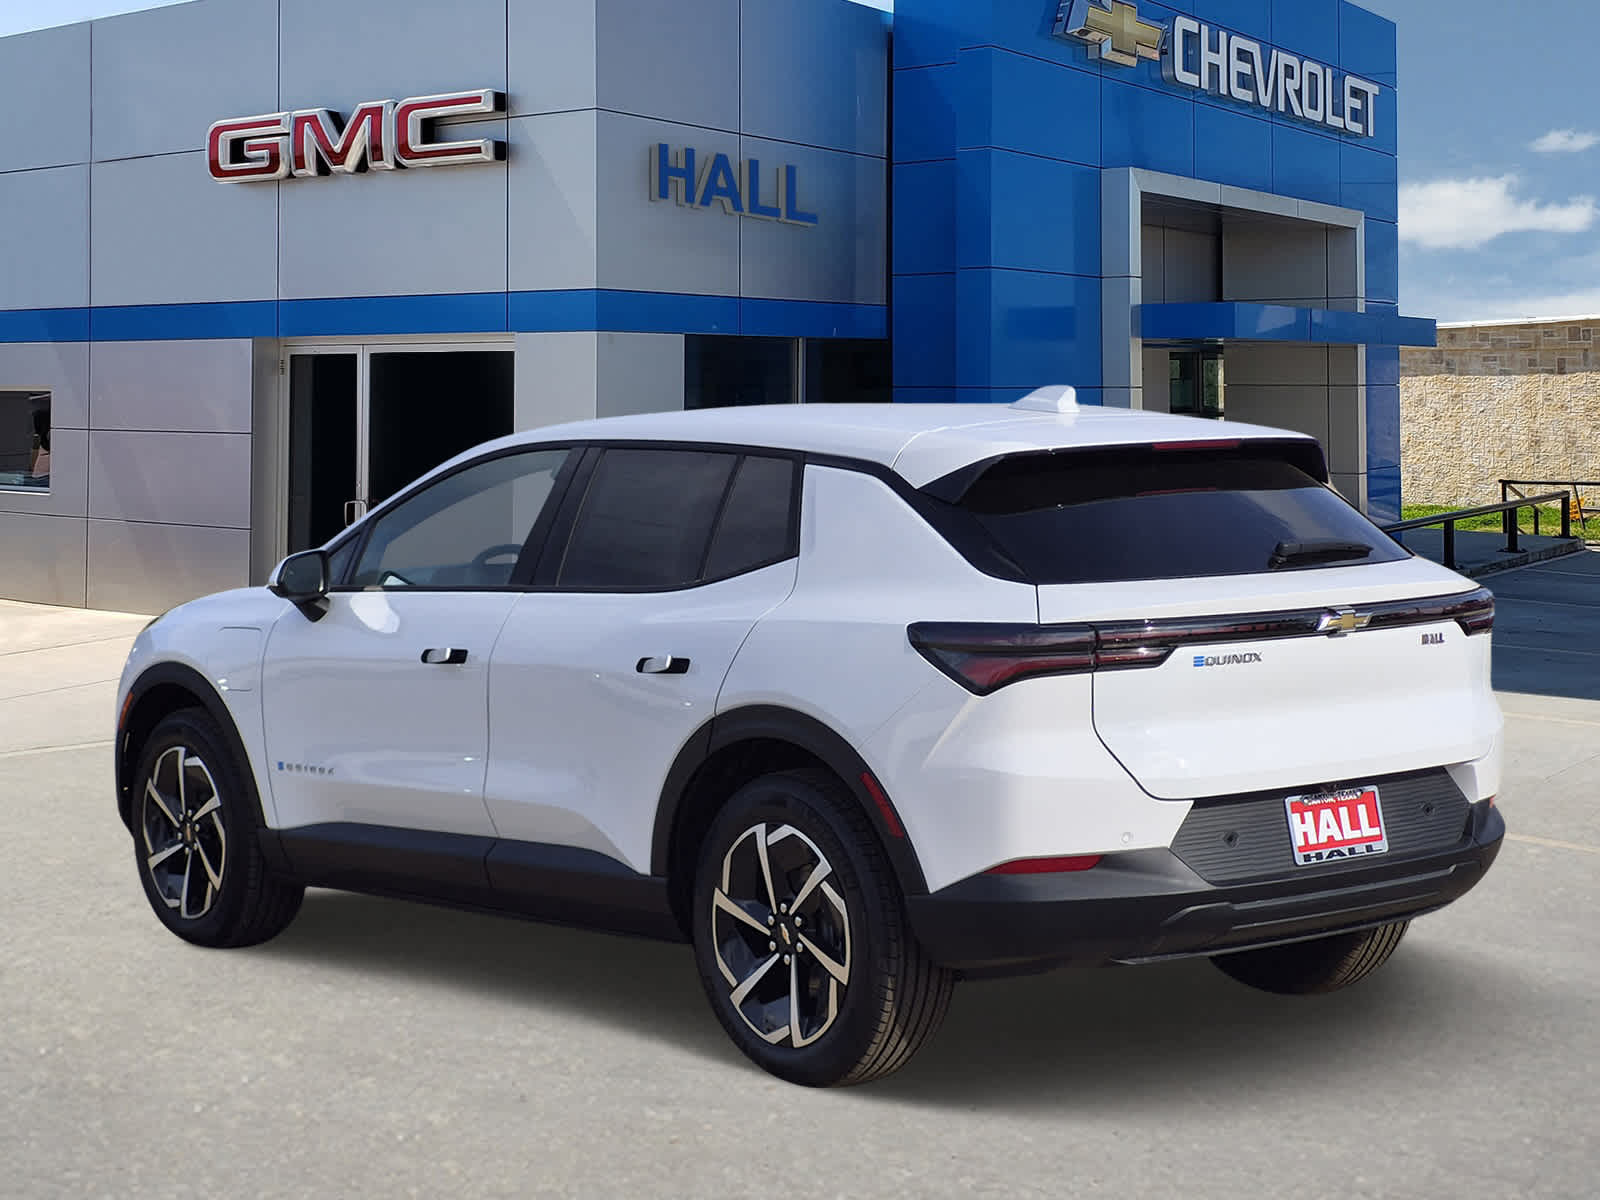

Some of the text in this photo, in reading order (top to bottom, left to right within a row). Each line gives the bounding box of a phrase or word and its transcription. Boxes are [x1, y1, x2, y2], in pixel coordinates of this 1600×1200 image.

[1174, 15, 1379, 137] CHEVROLET
[207, 88, 506, 184] GMC
[650, 143, 818, 227] HALL
[1193, 652, 1263, 668] EQUINOX
[1291, 804, 1380, 847] HALL
[1303, 845, 1383, 863] HALL
